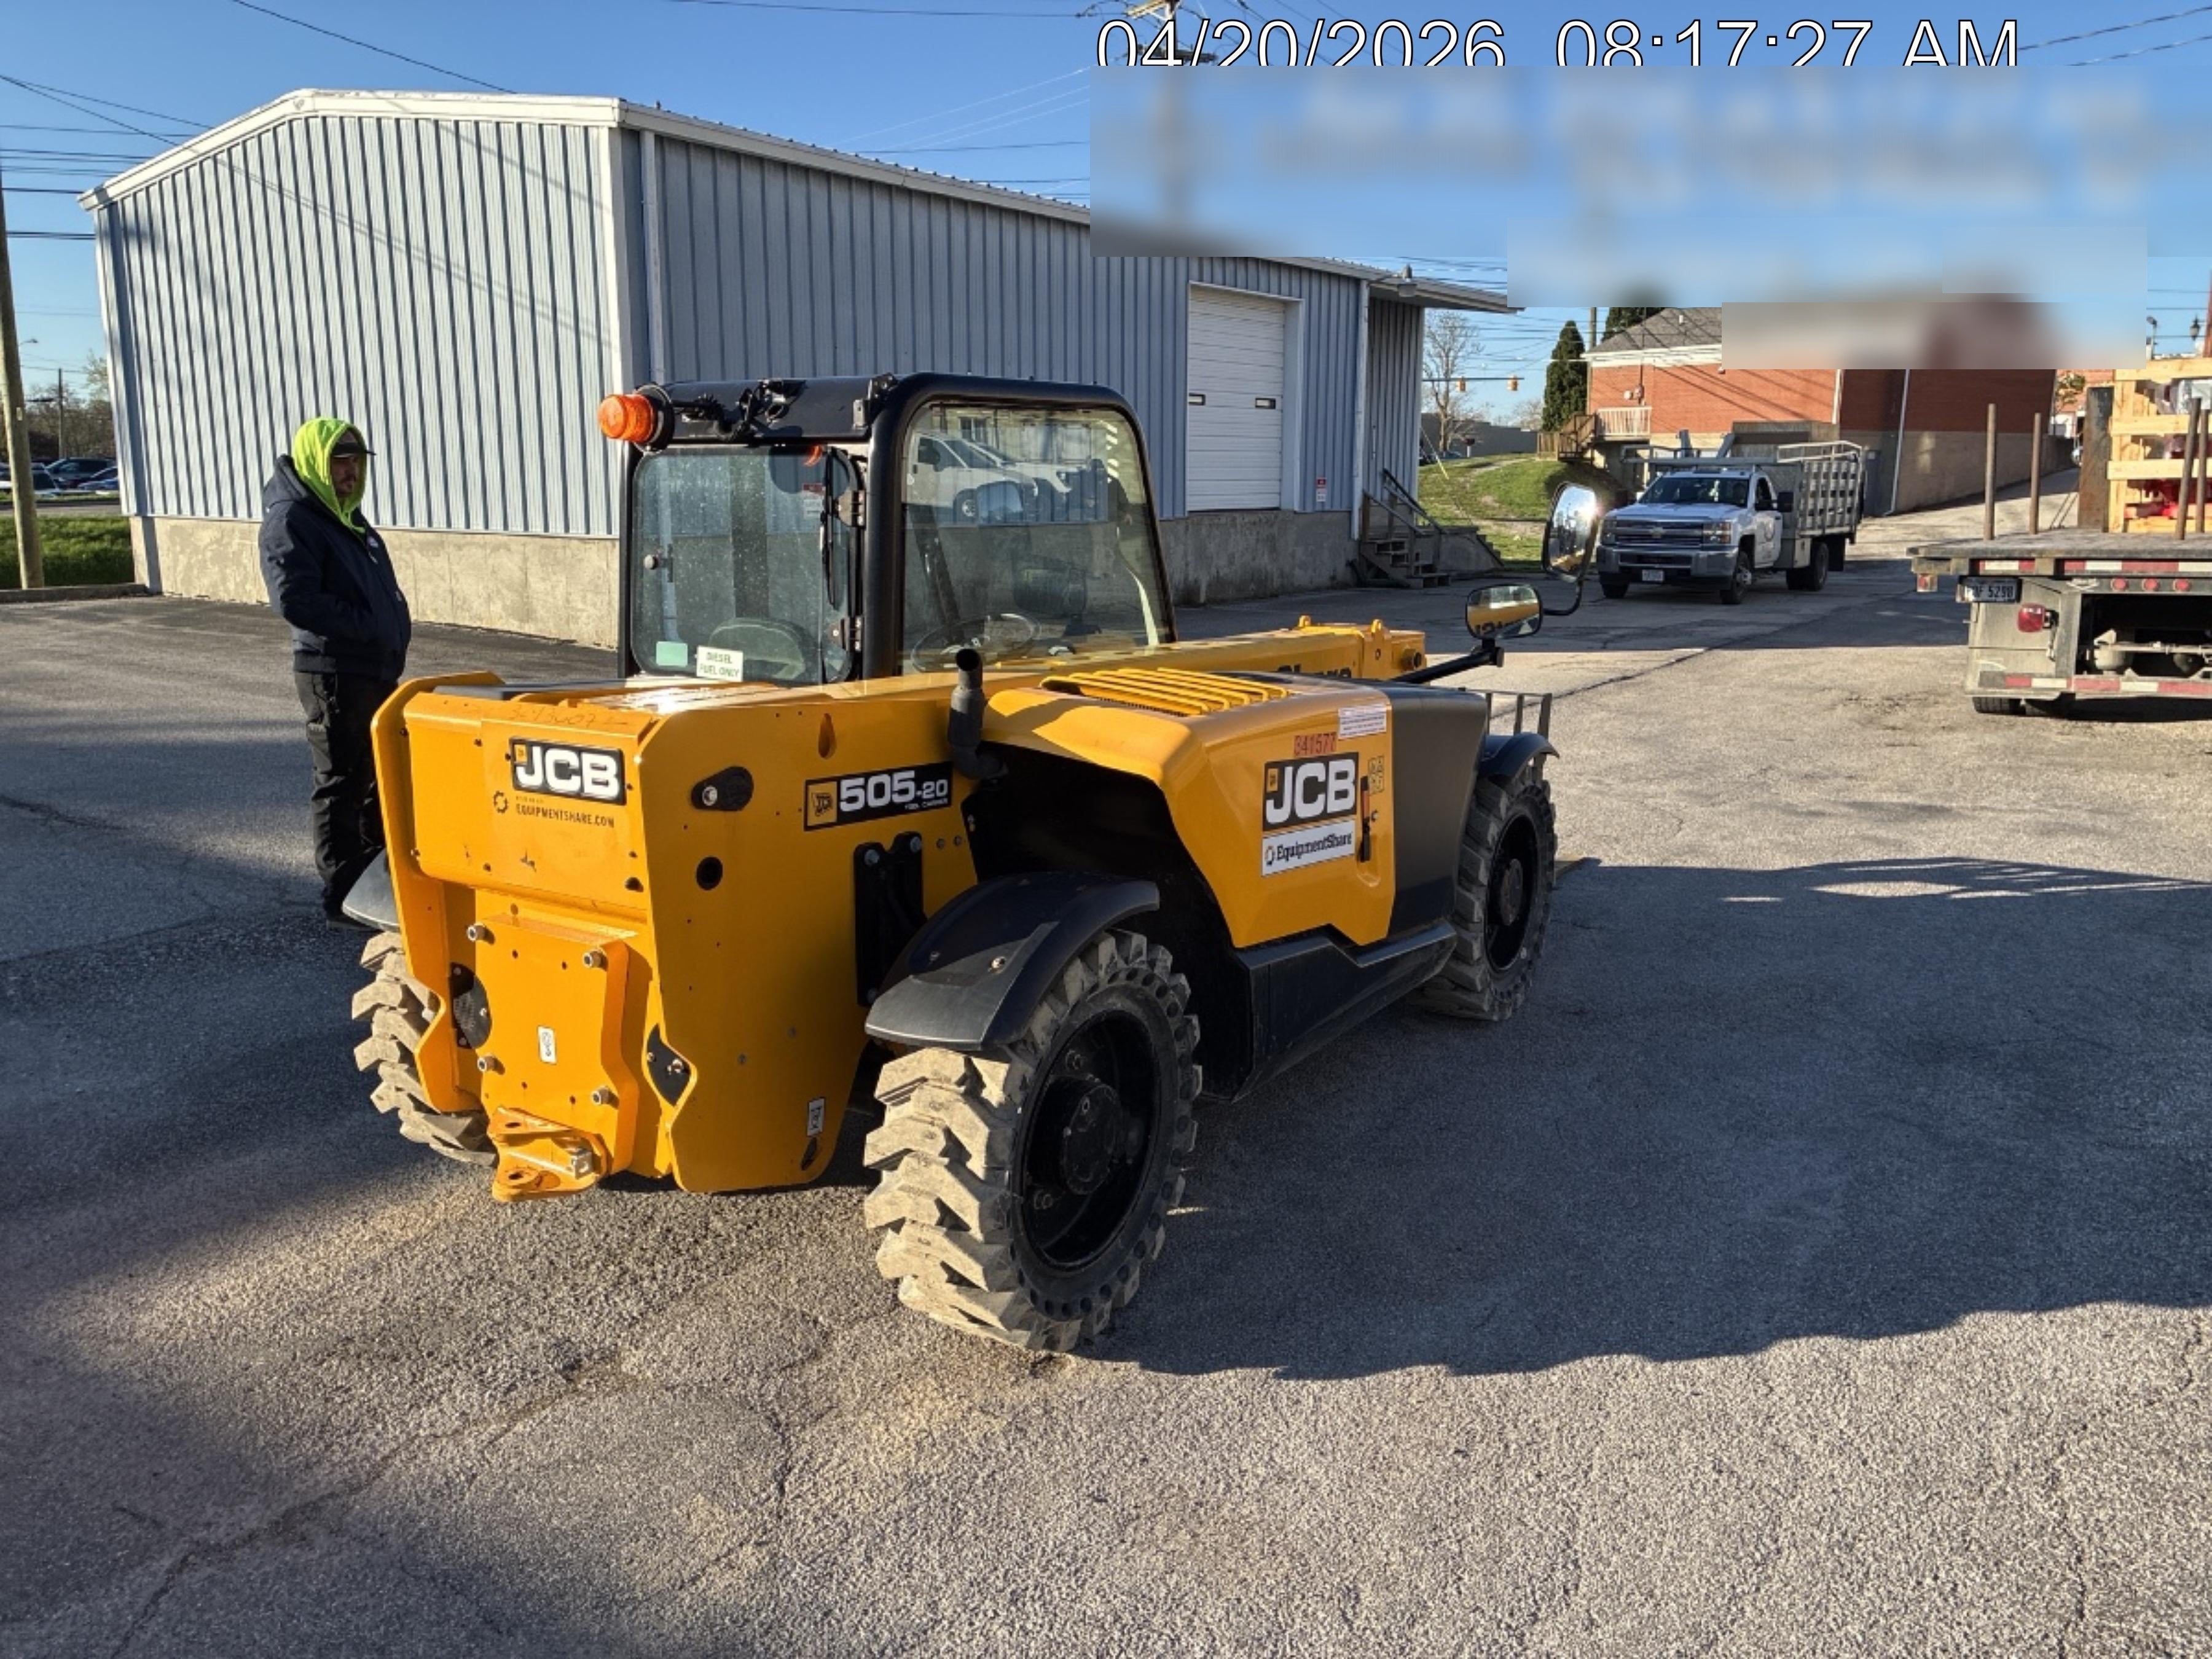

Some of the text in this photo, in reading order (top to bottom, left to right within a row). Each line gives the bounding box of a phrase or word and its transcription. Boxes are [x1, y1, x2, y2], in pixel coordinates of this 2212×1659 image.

[700, 664, 740, 677] FUEL ONLY
[707, 652, 733, 664] DIESEL
[516, 745, 620, 799] JCB
[839, 770, 949, 812] 505-20
[1265, 759, 1355, 825] JCB
[516, 804, 614, 828] EQUIPMENTSHARE.COM
[1277, 833, 1352, 862] EquipmentShare
